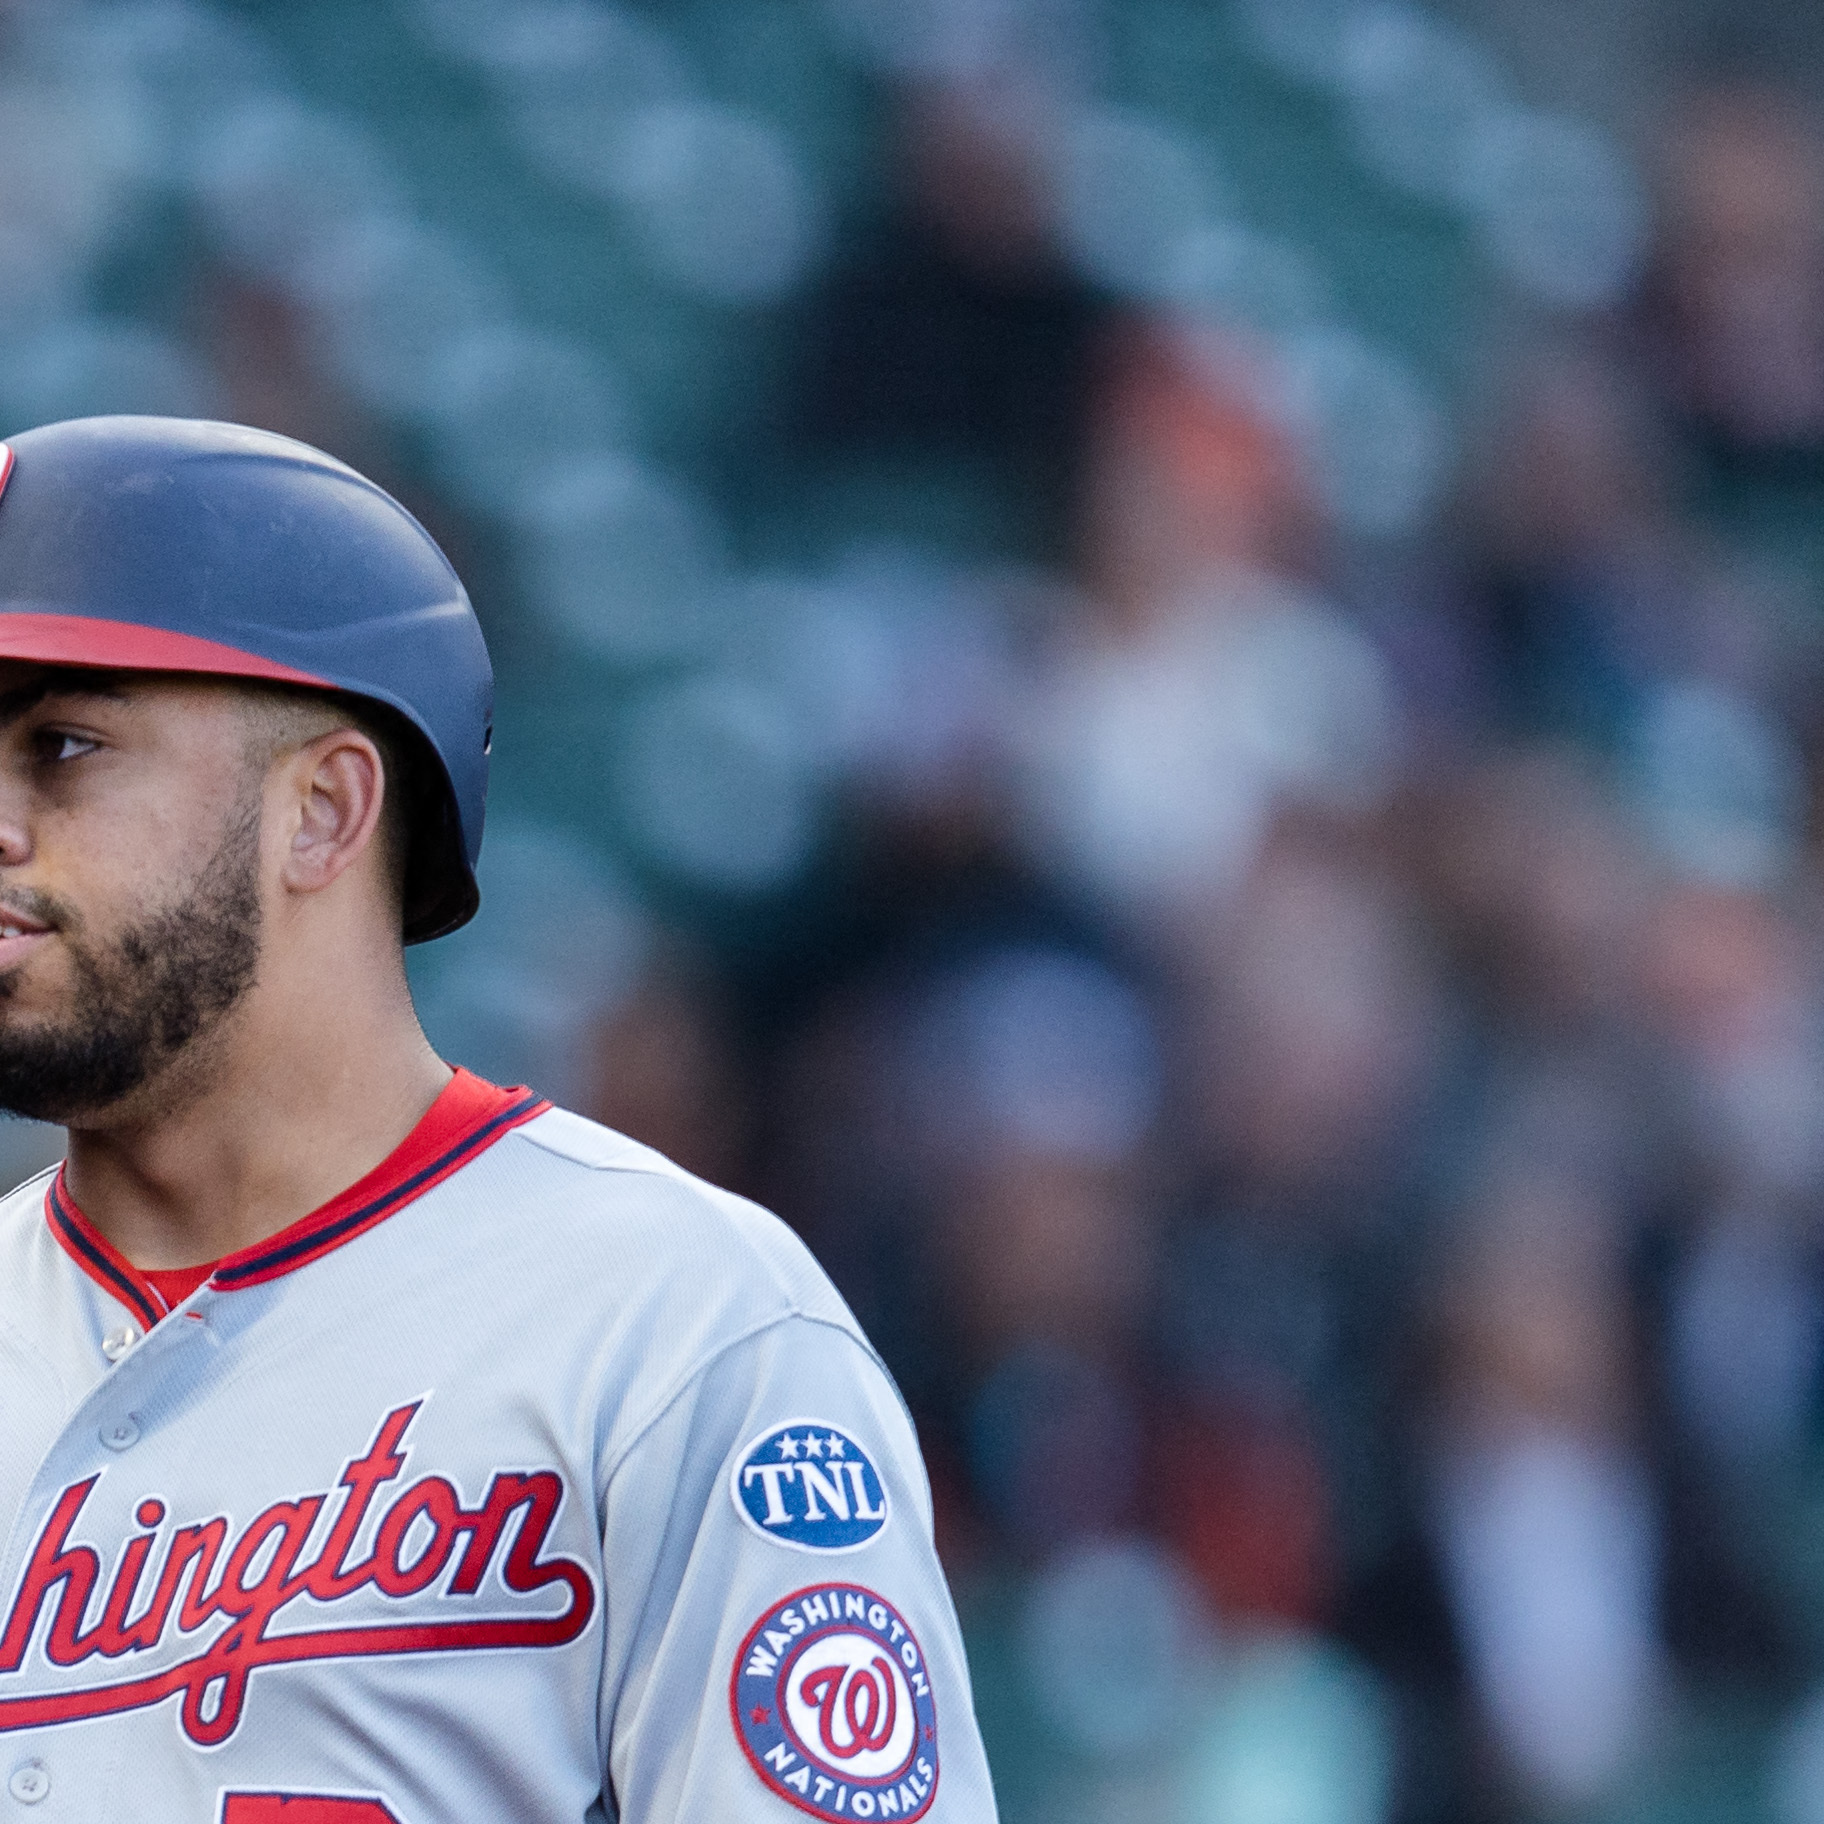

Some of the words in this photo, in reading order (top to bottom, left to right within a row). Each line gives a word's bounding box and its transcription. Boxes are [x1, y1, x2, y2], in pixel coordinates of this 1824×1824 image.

[743, 1460, 886, 1526] TNL
[745, 1590, 930, 1698] WASHINGTON
[799, 1656, 897, 1760] W
[763, 1741, 934, 1818] NATIONALS
